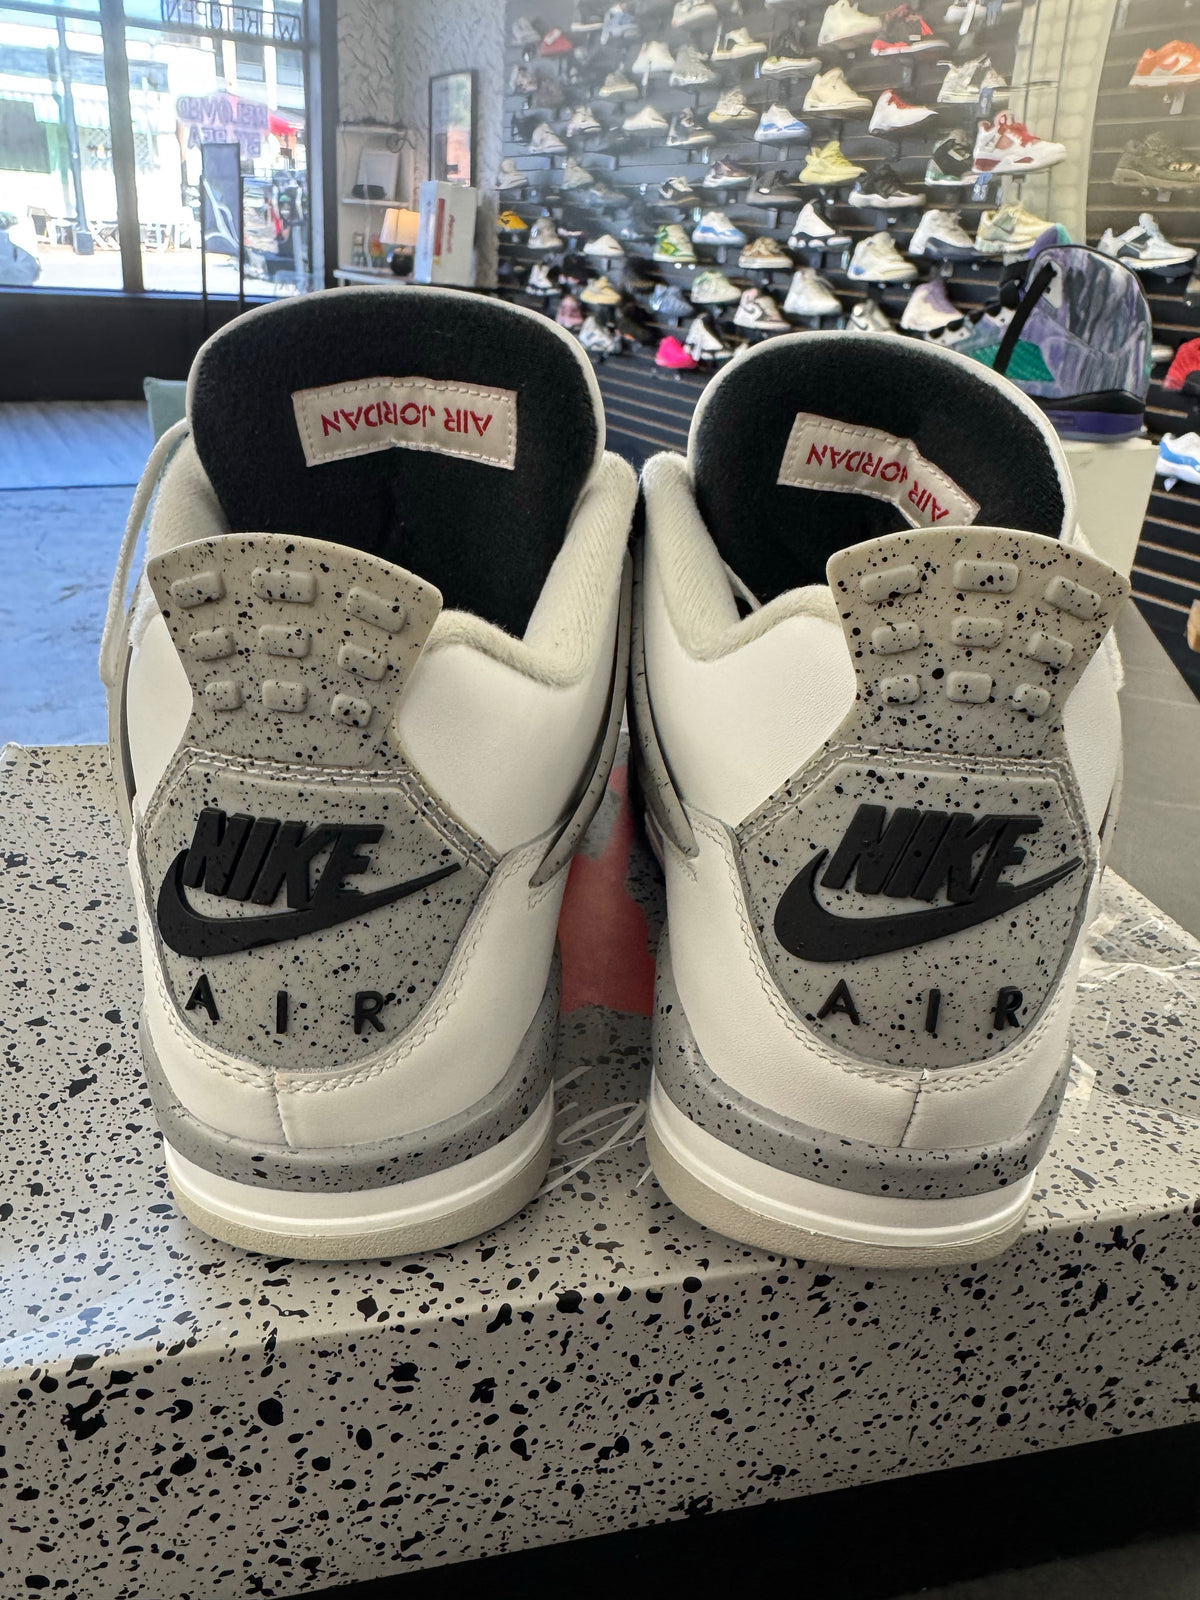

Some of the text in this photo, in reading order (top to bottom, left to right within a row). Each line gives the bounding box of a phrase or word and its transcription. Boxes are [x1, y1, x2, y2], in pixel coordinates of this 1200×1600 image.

[320, 400, 493, 437] AIR JORDAN
[806, 443, 950, 523] AIR JORDAN
[183, 806, 385, 909] NIKE
[820, 803, 1043, 903] NIKE
[184, 974, 386, 1036] AIR
[817, 979, 1024, 1034] AIR
